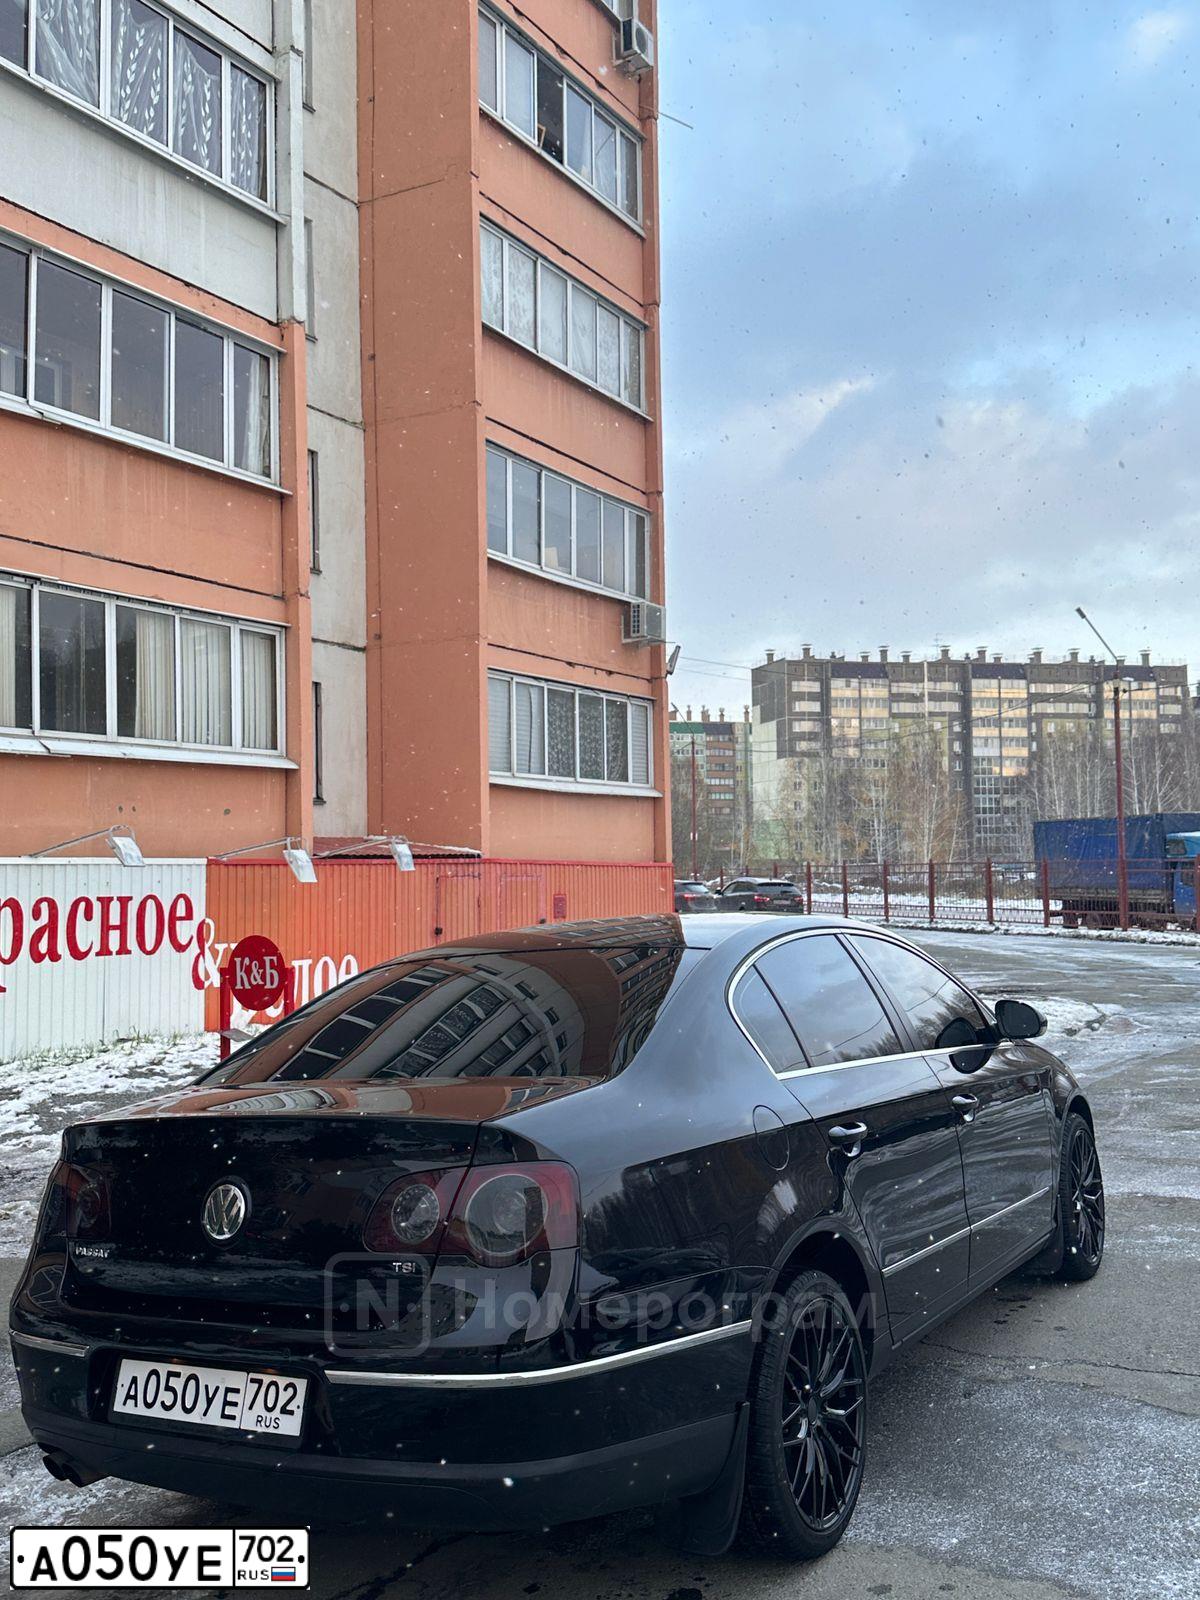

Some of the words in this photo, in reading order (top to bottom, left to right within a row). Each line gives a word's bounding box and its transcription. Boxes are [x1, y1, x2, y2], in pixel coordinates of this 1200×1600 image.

[234, 956, 279, 990] К&Б
[392, 1262, 416, 1273] TSI
[122, 1368, 241, 1421] А050УЕ
[248, 1378, 298, 1416] 702
[255, 1414, 281, 1429] RUS
